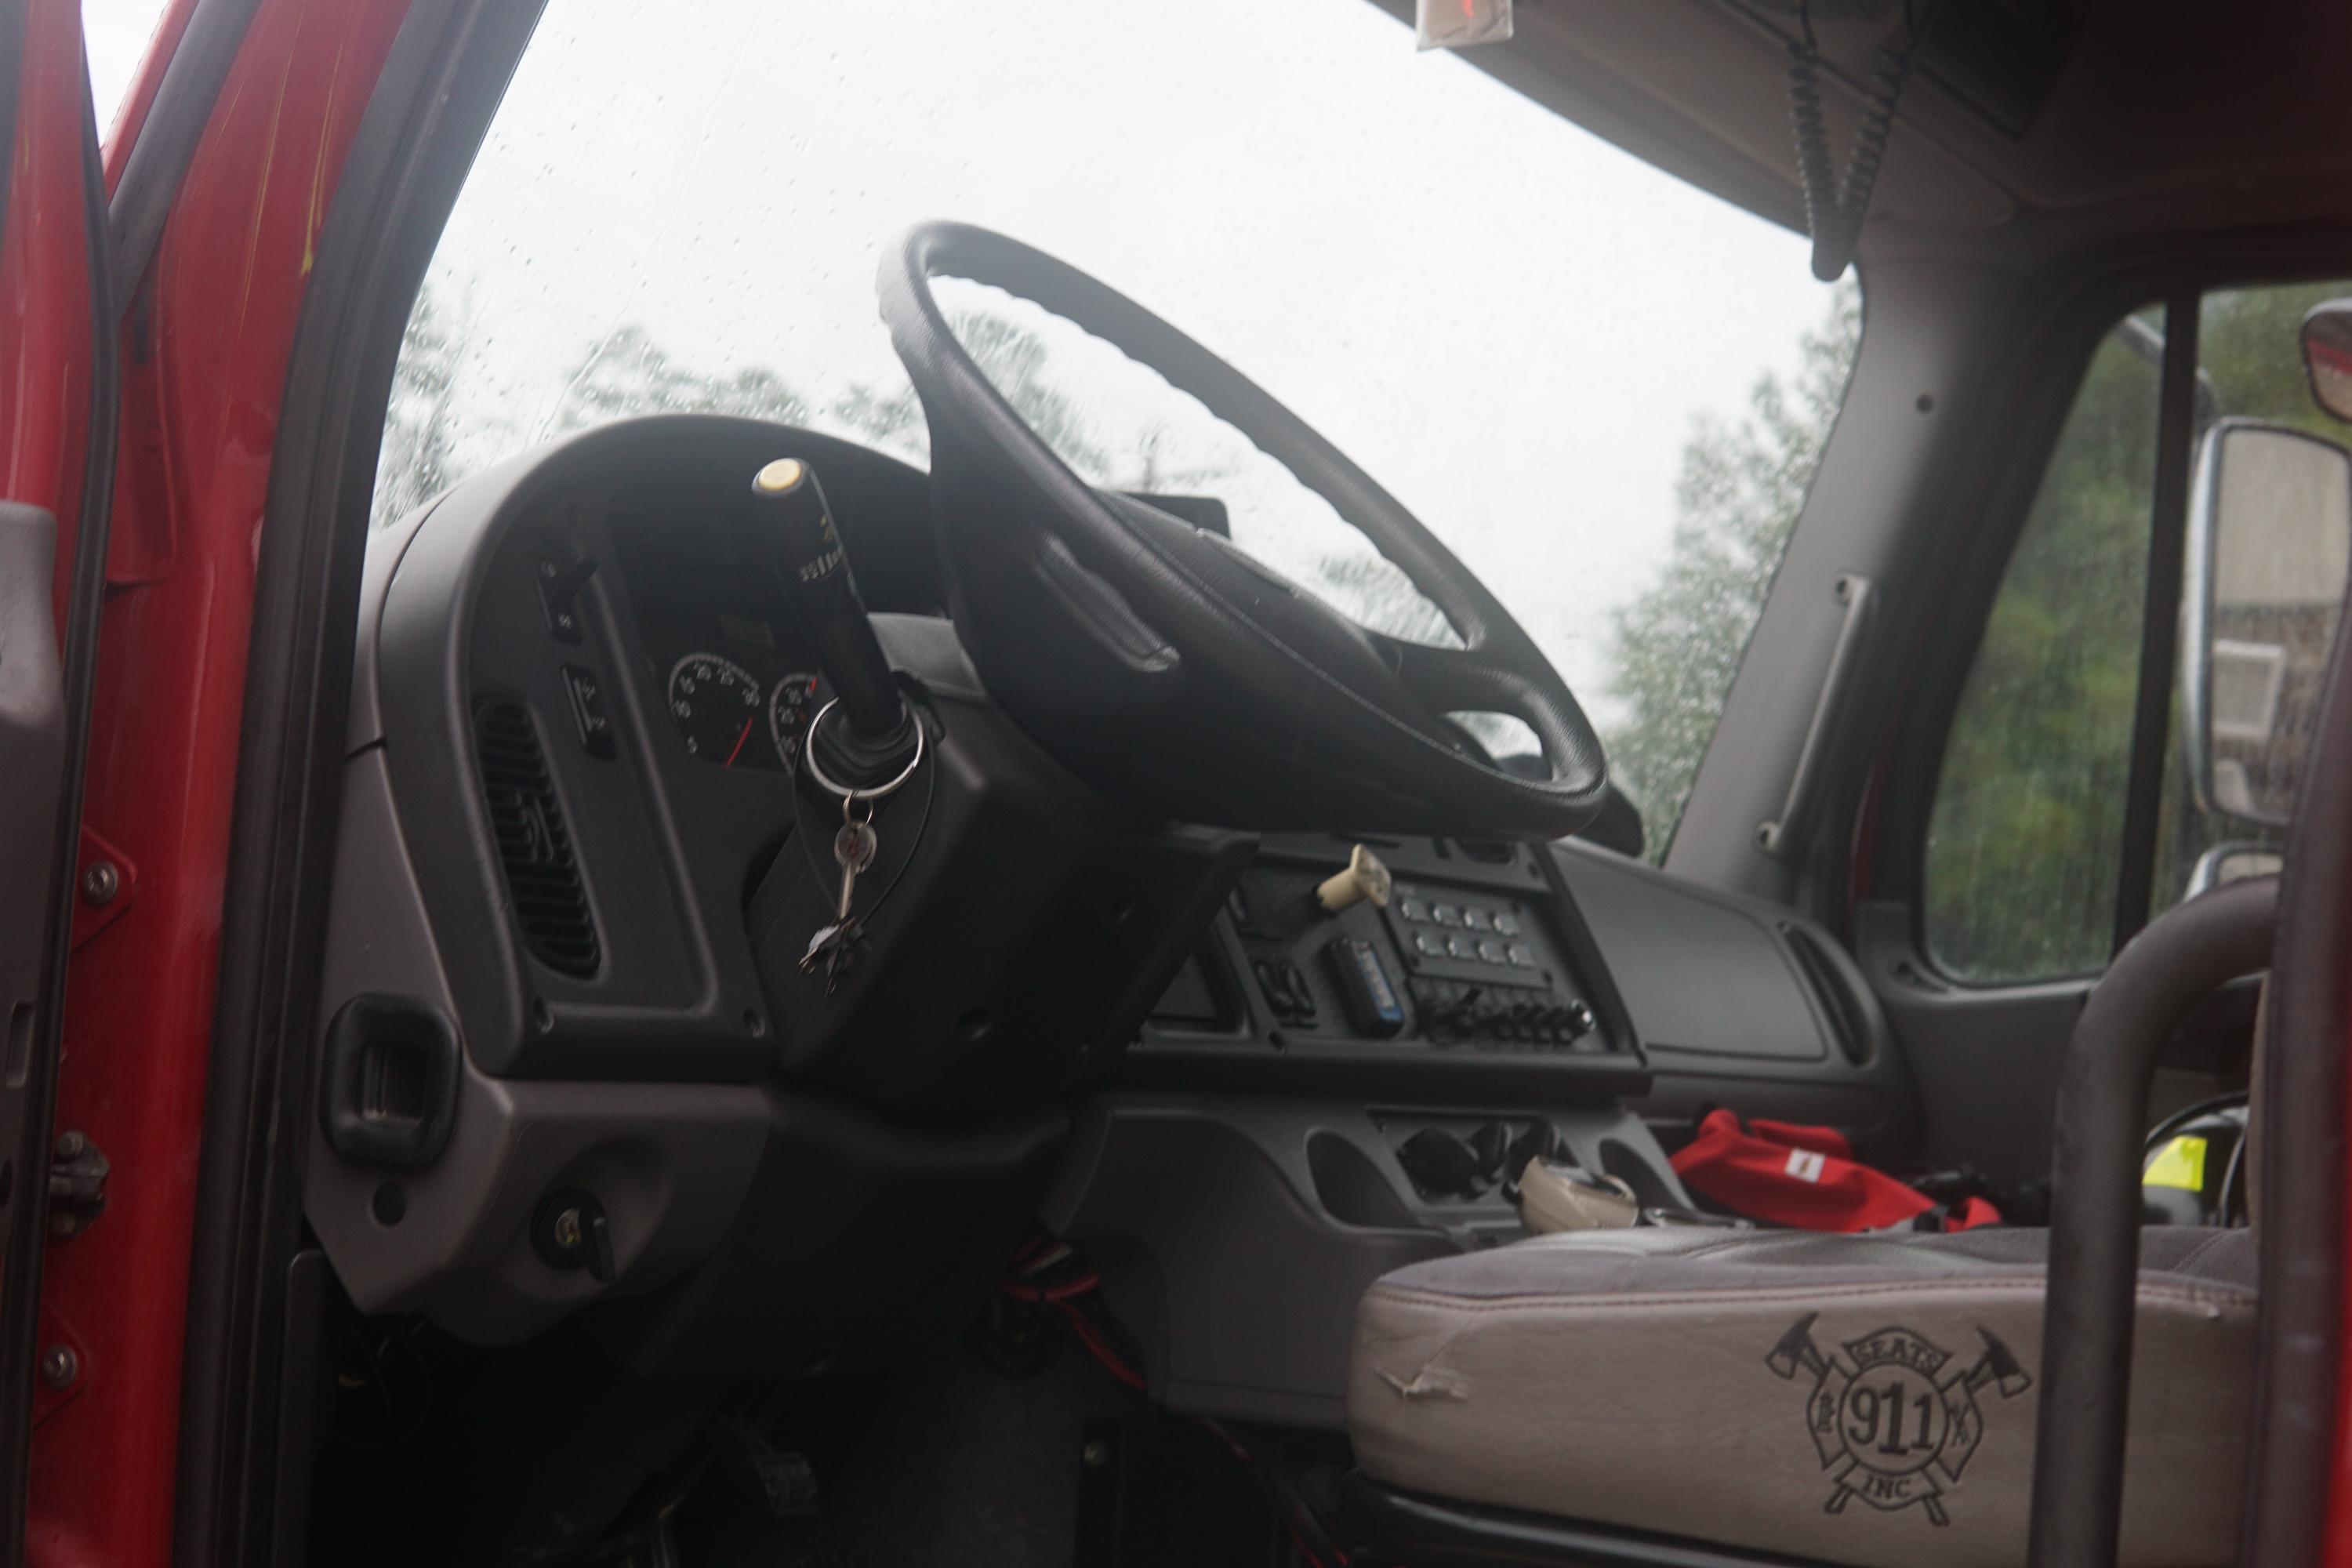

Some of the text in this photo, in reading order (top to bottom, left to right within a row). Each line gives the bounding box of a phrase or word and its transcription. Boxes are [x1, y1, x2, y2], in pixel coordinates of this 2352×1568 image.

[1853, 1338, 1941, 1373] SEATS
[1848, 1381, 1934, 1456] 911
[1863, 1475, 1913, 1499] INC
